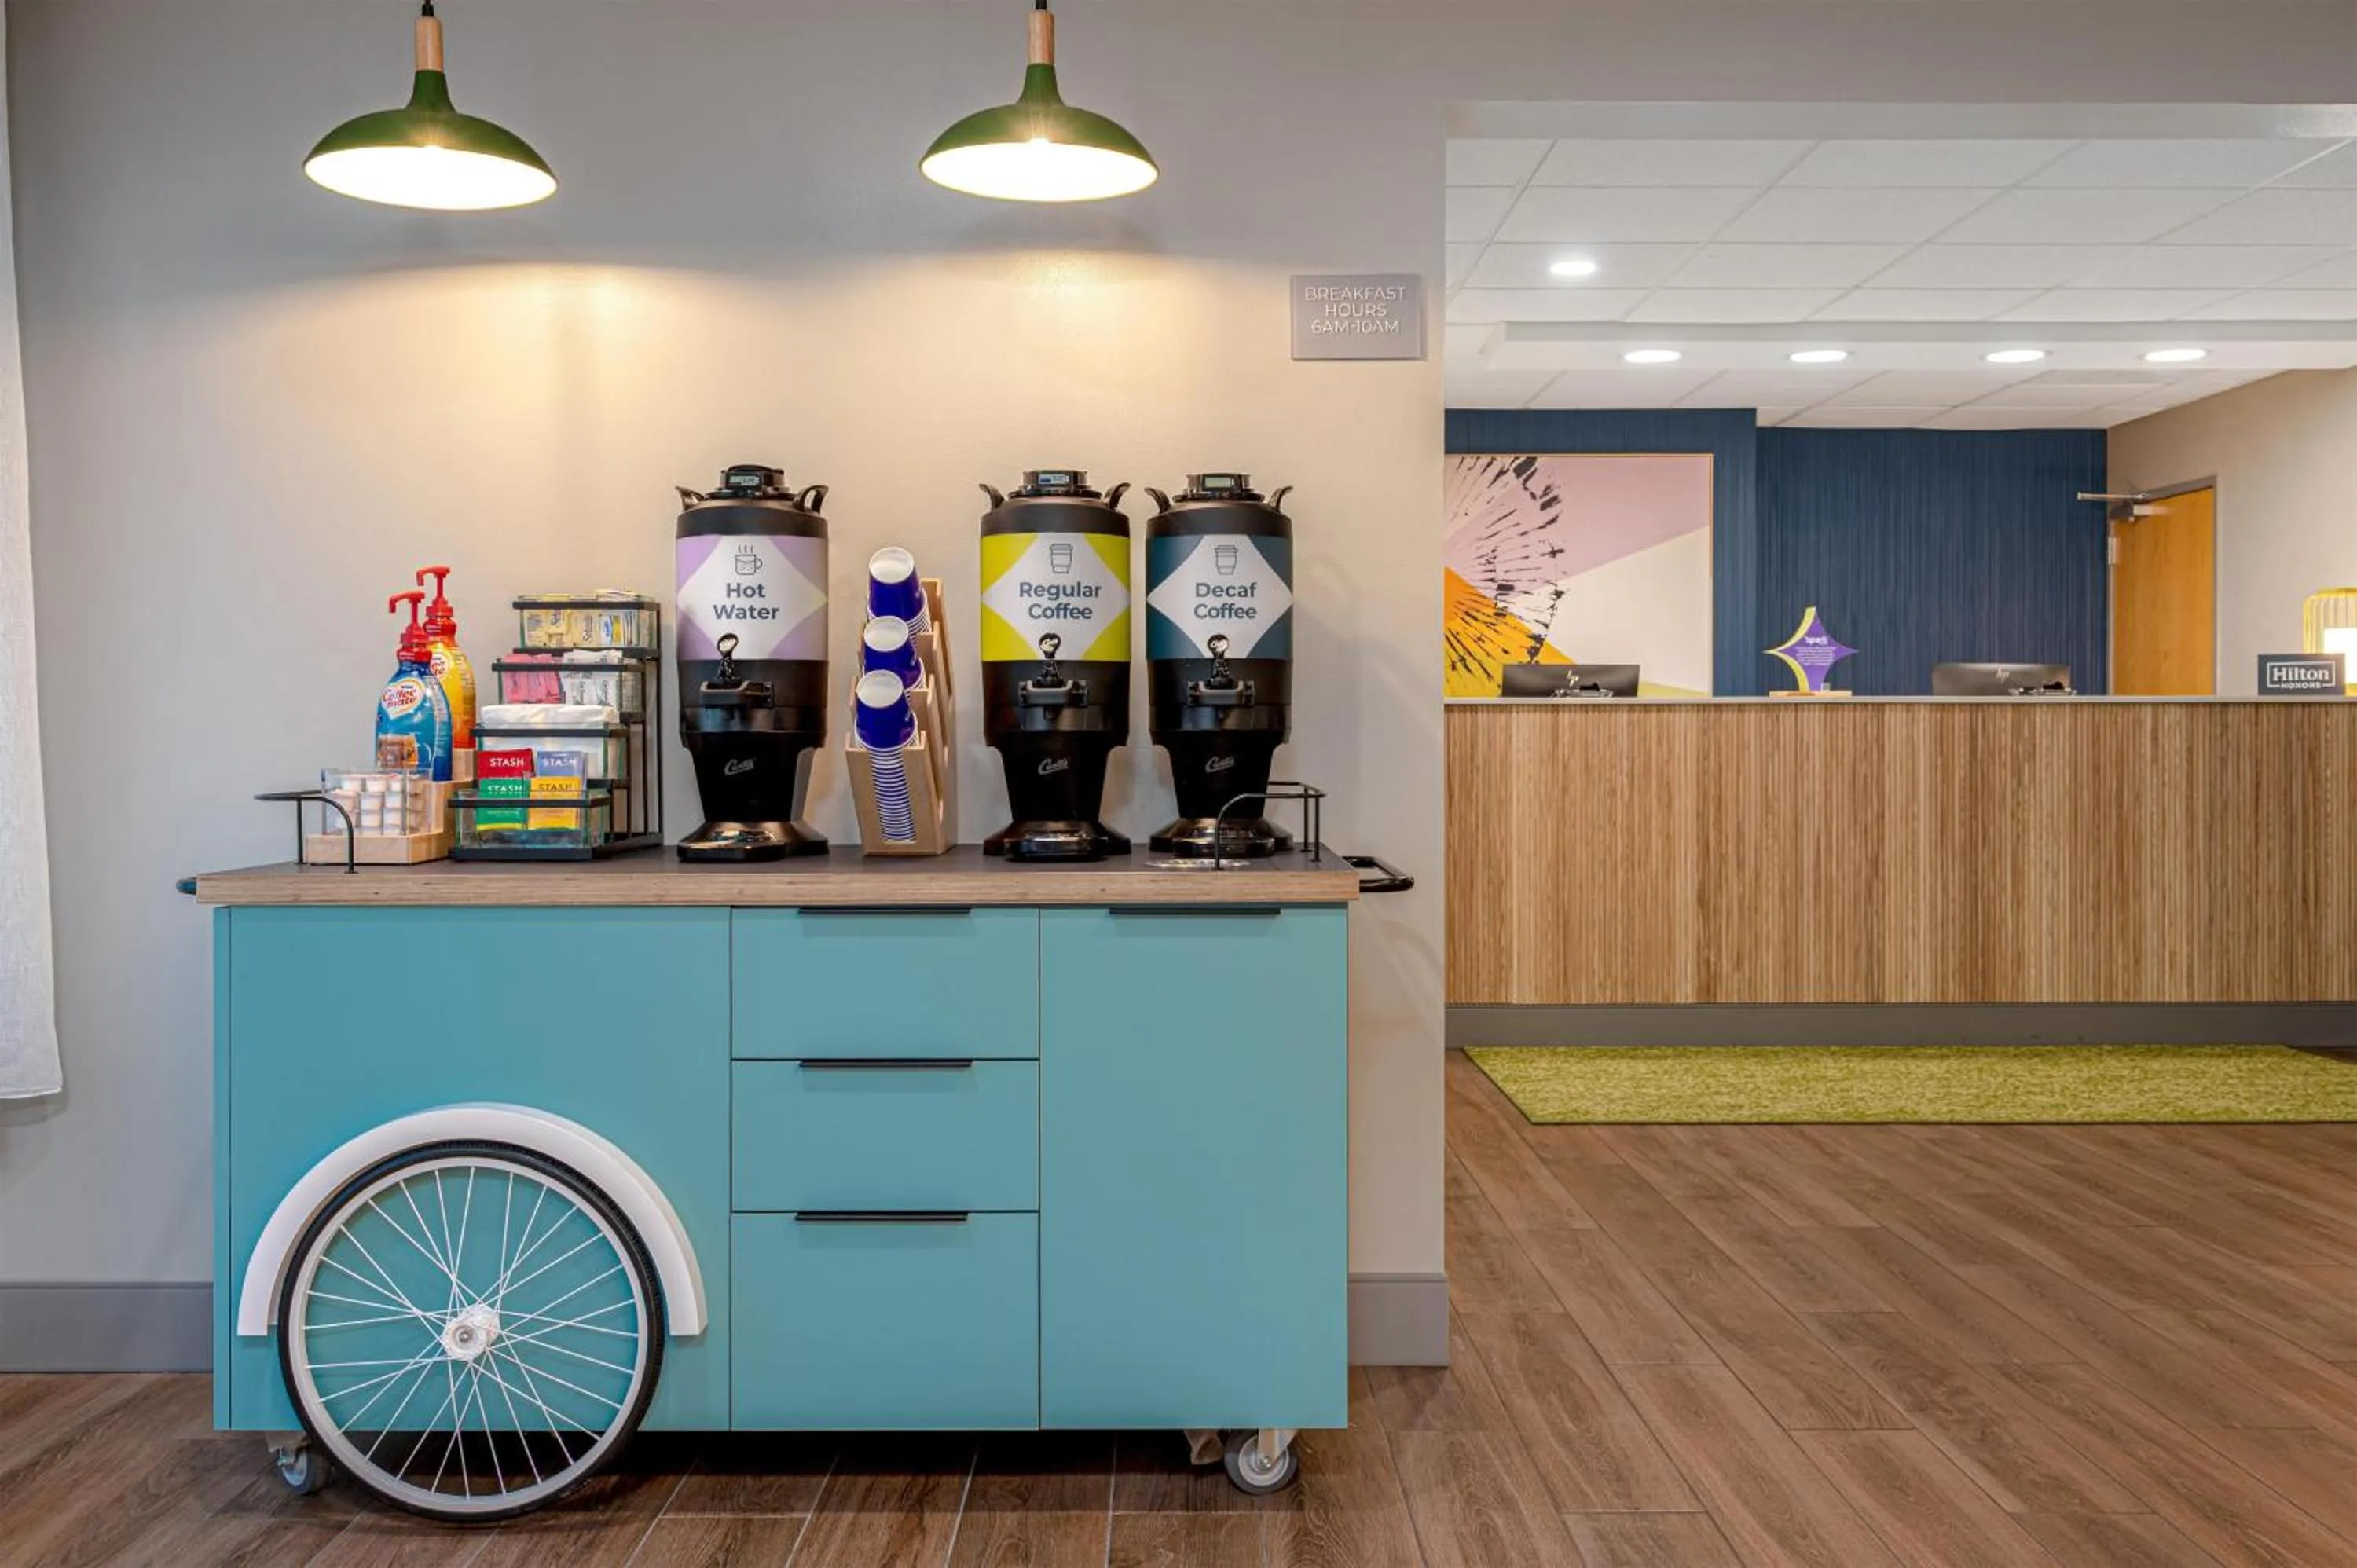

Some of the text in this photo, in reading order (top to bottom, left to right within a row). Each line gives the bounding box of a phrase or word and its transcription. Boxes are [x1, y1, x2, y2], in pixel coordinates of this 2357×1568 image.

[1304, 286, 1406, 301] BREAKFAST
[1325, 303, 1387, 317] HOURS
[1310, 319, 1400, 334] 6AM-10AM
[725, 582, 766, 599] Hot
[1019, 581, 1102, 603] Regular
[1195, 581, 1258, 598] Decaf
[713, 604, 780, 621] Water
[1028, 603, 1093, 619] Coffee
[1193, 603, 1258, 619] Coffee
[2273, 667, 2330, 681] Hilton
[489, 757, 525, 768] STASH
[543, 757, 577, 767] STASH
[487, 784, 522, 795] STASH
[538, 783, 573, 793] STASH
